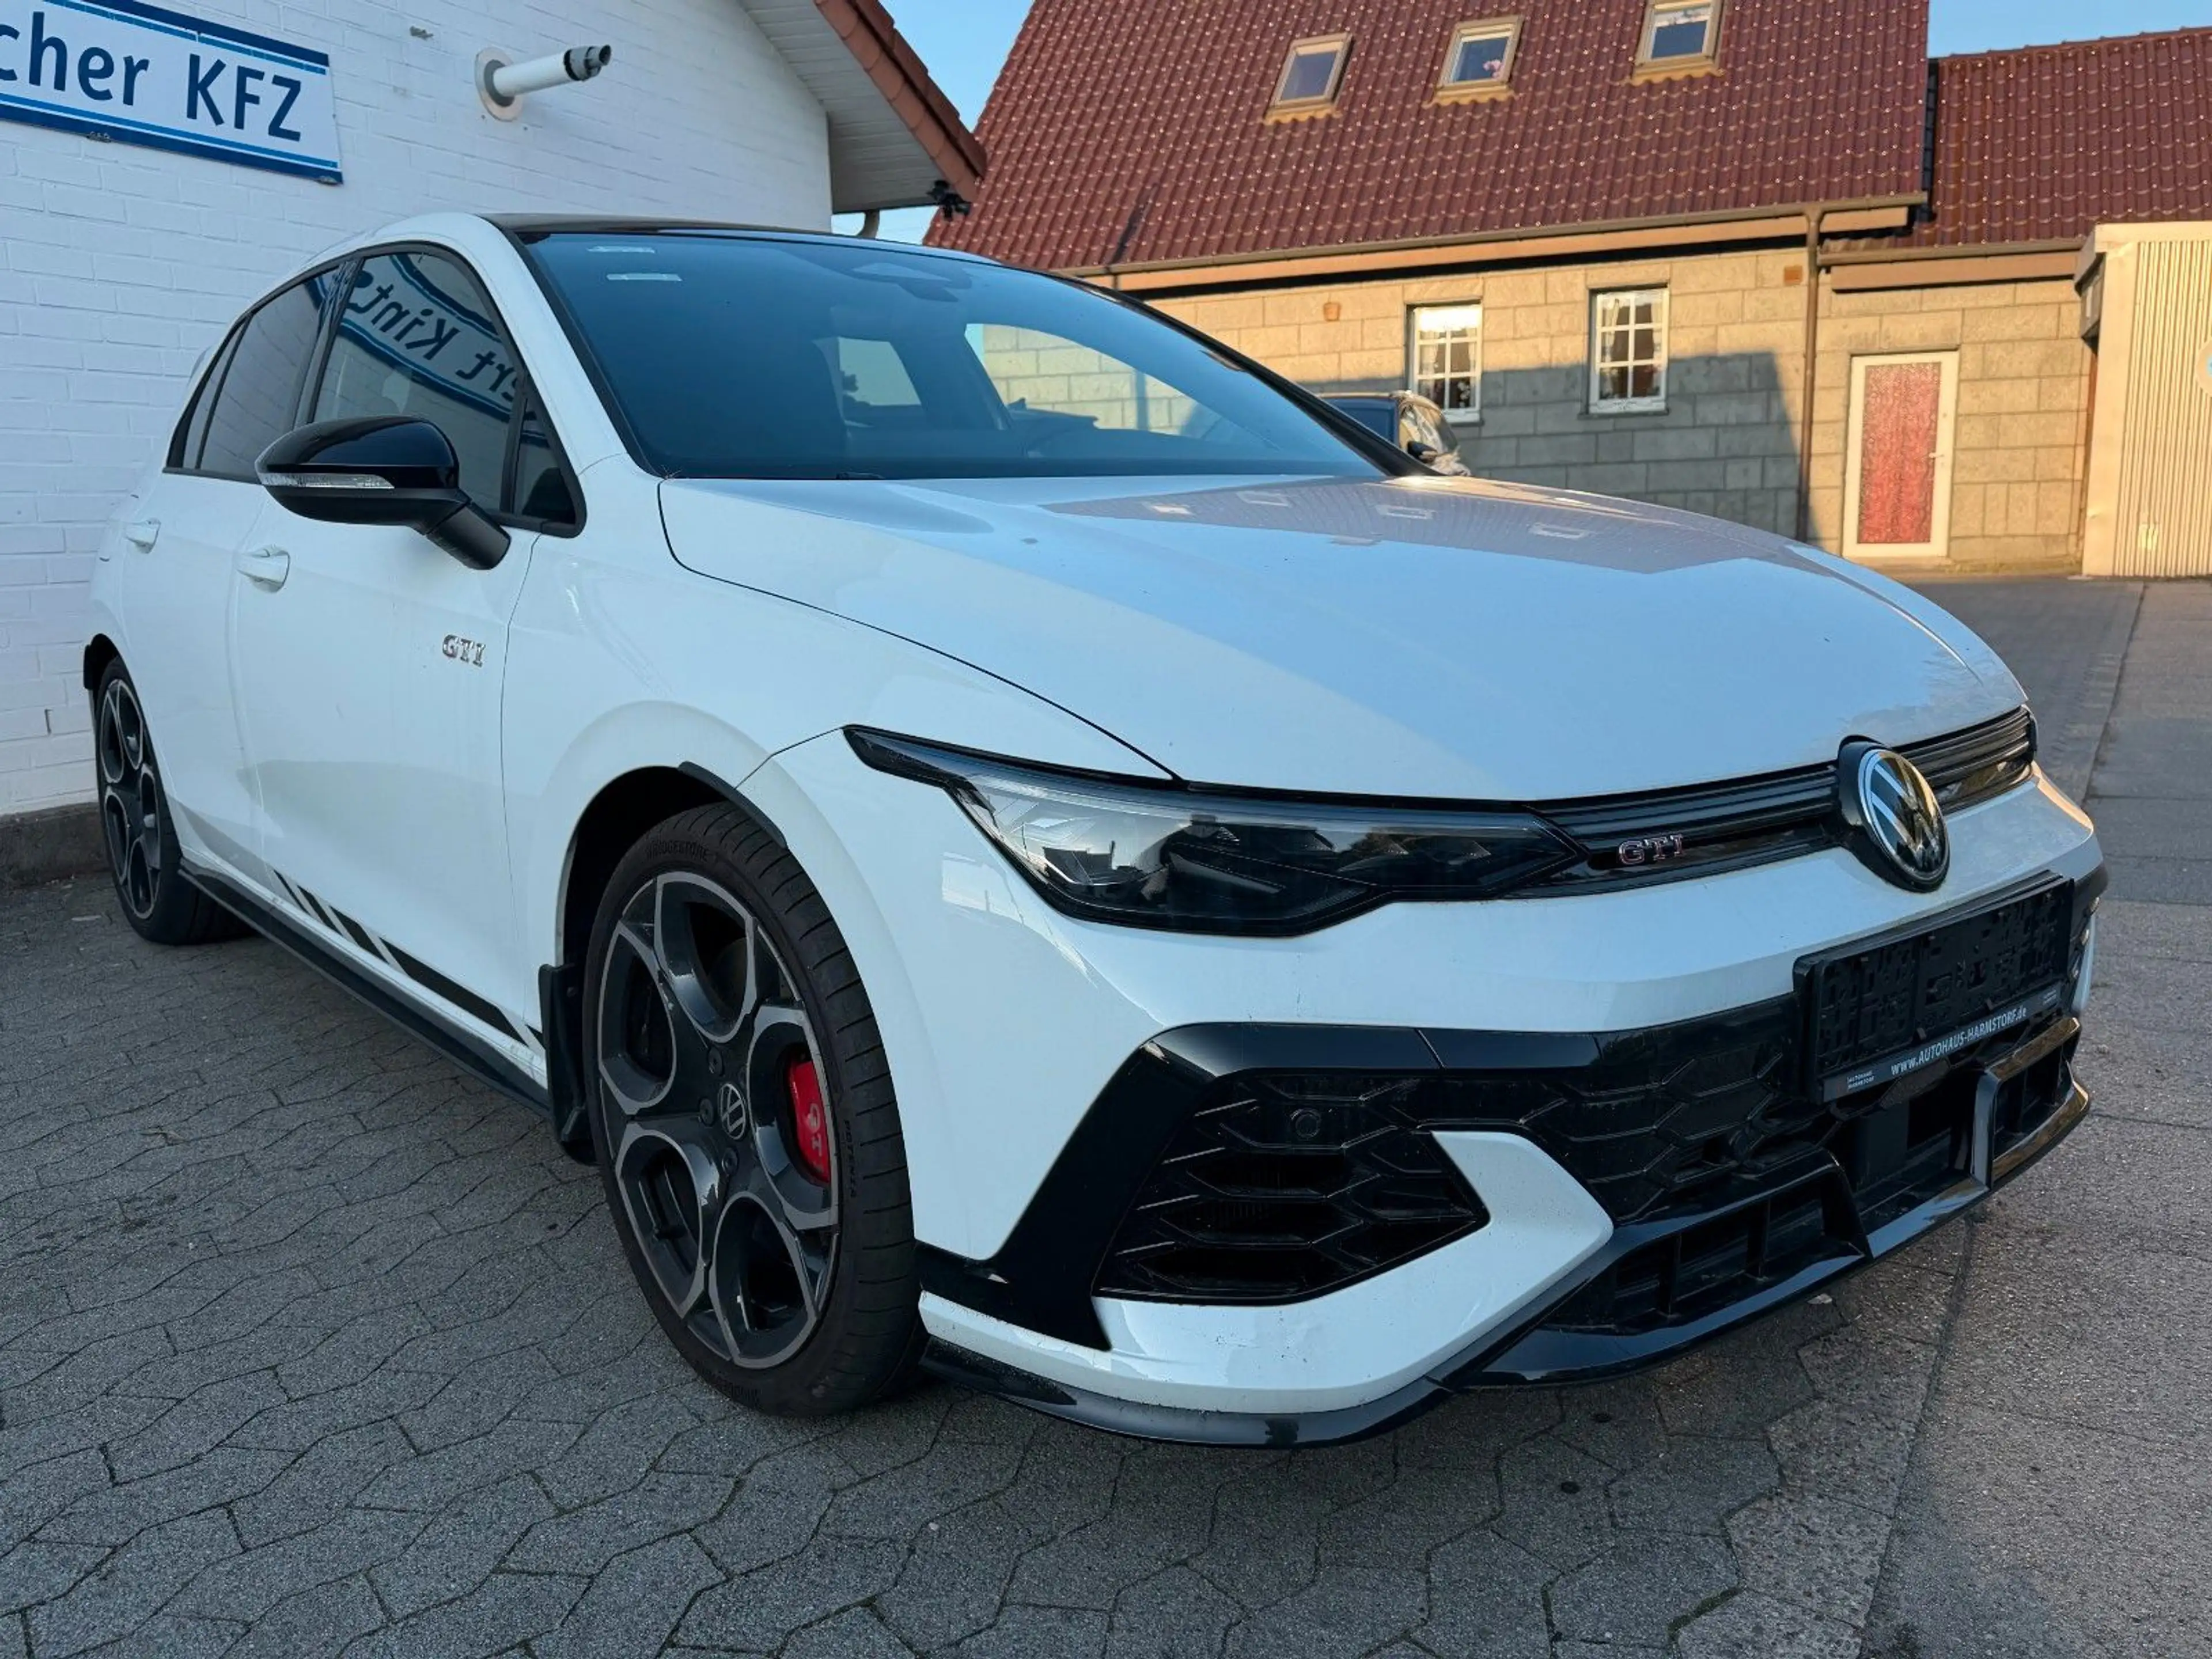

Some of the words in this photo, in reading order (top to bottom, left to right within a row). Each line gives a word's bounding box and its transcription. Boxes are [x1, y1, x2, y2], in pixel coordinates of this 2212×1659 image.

[186, 54, 302, 142] KFZ
[443, 634, 486, 667] GTI
[1619, 834, 1684, 865] GTI
[1891, 1005, 2027, 1075] www.AUTOHAUS-HARMSTORF.de
